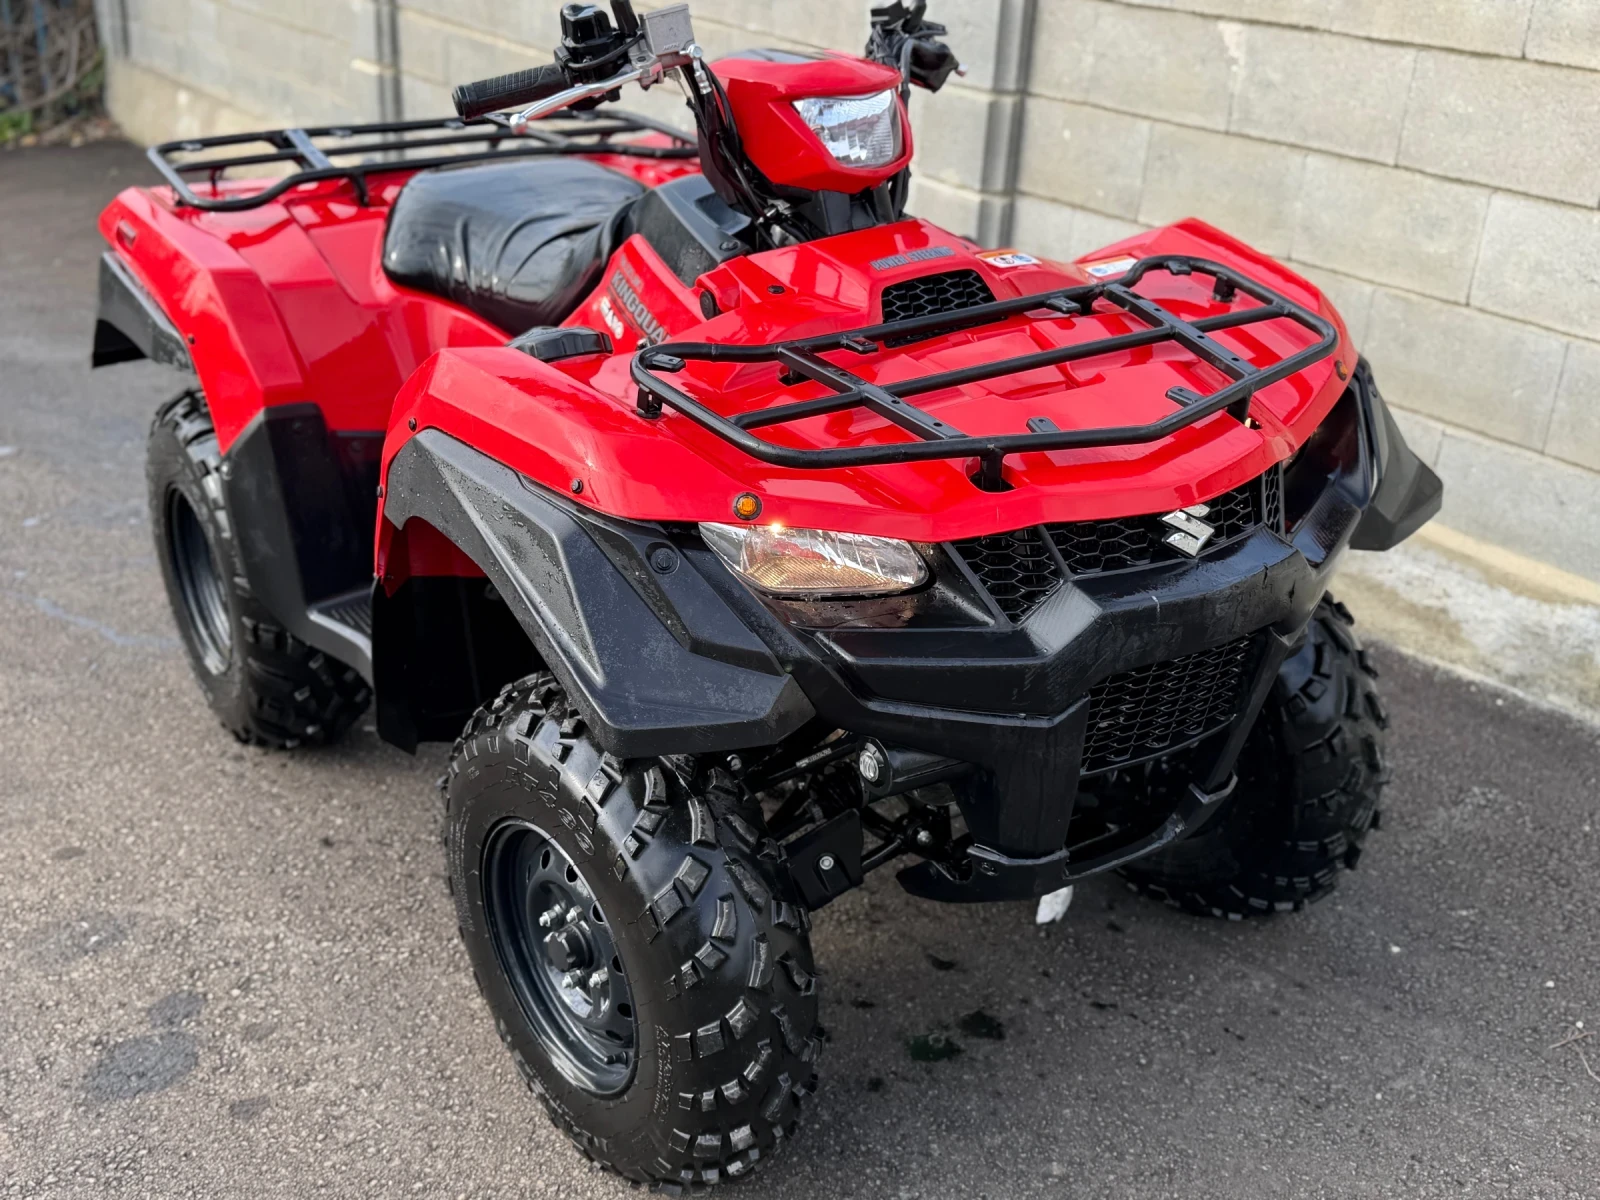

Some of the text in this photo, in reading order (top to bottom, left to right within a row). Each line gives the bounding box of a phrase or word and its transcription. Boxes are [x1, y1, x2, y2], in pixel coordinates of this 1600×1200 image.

[869, 246, 956, 272] POWER STEERING
[611, 269, 672, 345] KINGQUA
